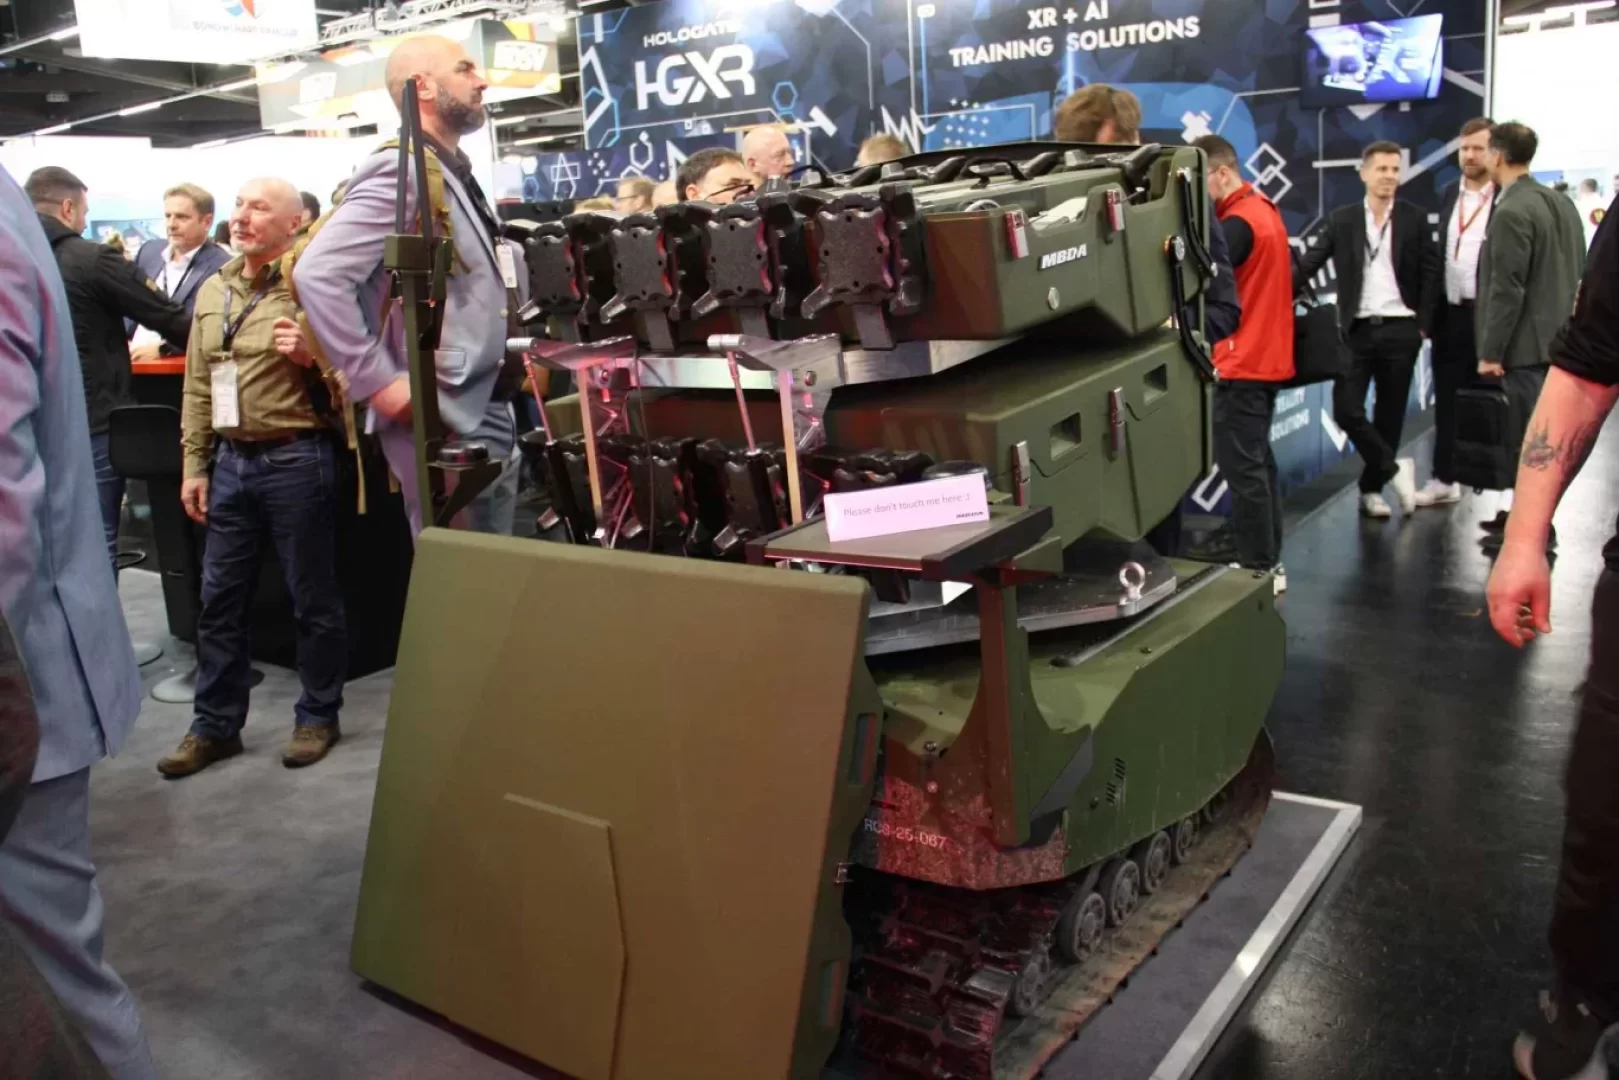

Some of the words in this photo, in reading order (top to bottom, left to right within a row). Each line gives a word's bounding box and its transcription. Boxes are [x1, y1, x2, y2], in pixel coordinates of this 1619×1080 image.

[1027, 6, 1057, 29] XR
[1084, 0, 1109, 22] AI
[949, 36, 1054, 67] TRAINING
[1066, 15, 1200, 51] SOLUTIONS
[1041, 243, 1087, 269] MBDA
[843, 504, 872, 517] Please
[874, 501, 897, 513] don't
[899, 497, 924, 510] touch
[926, 497, 941, 505] me
[941, 492, 962, 504] here
